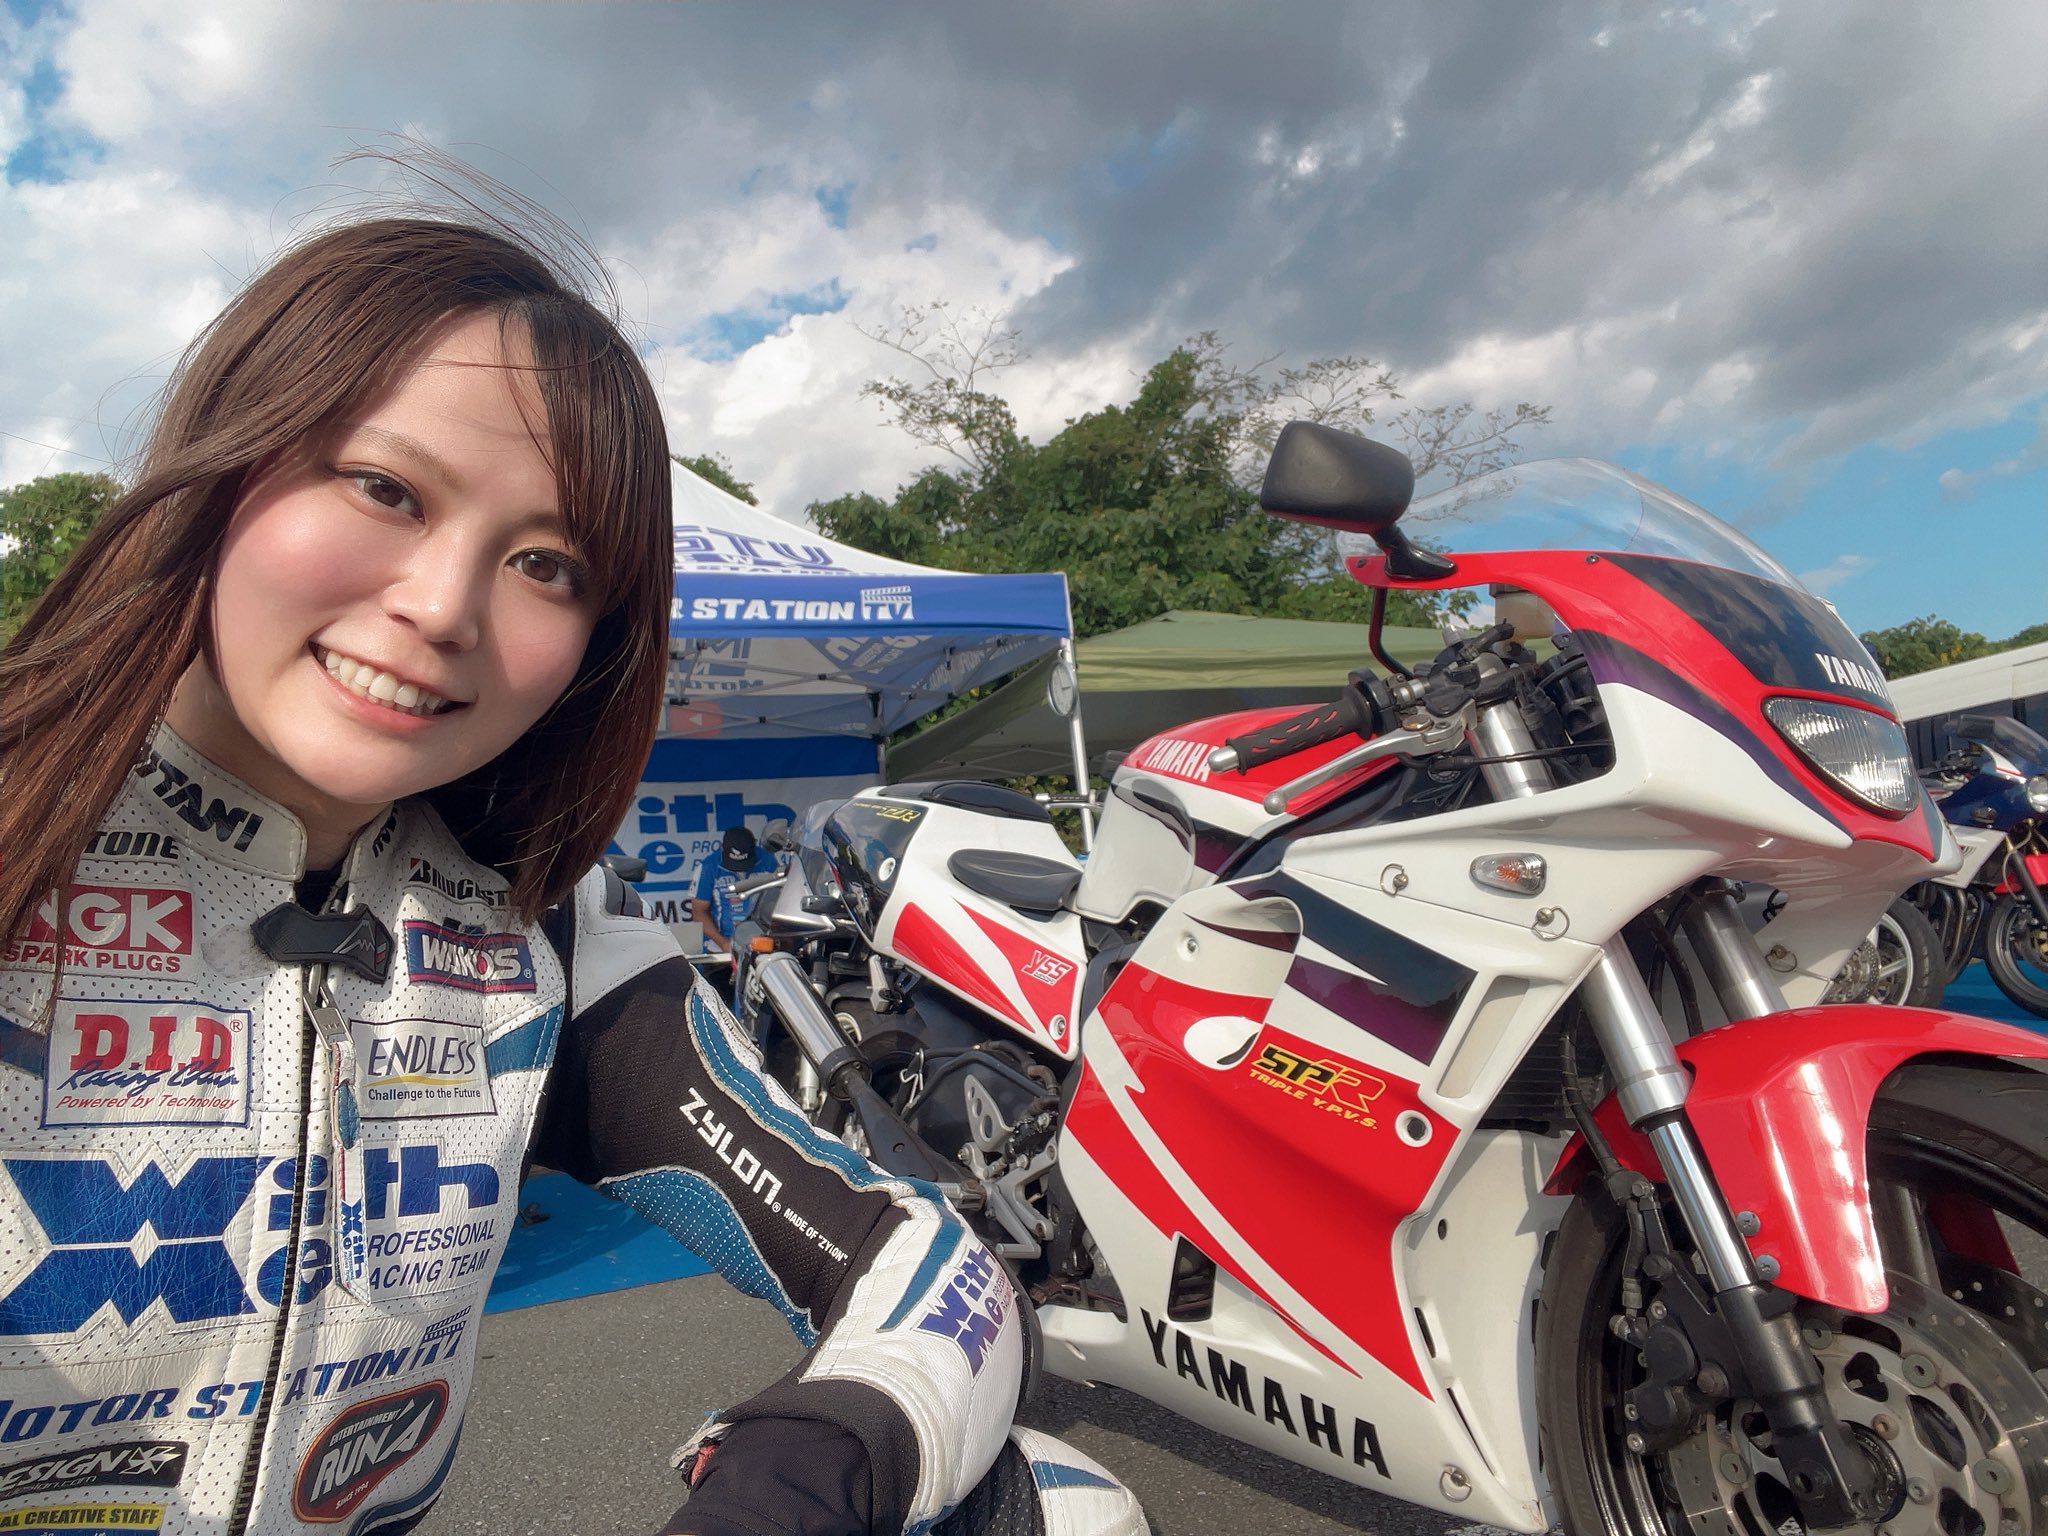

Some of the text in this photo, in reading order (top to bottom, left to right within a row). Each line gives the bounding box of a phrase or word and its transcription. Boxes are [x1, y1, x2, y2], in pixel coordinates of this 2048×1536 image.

[691, 598, 855, 620] STATION
[1143, 738, 1220, 783] YAMAHA
[148, 750, 264, 853] TANI
[638, 793, 797, 833] ith
[4, 943, 181, 973] SPARK PLUGS
[1020, 950, 1073, 980] YSS
[368, 1035, 476, 1077] ENDLESS
[57, 1060, 239, 1097] Racing Chain
[368, 1087, 481, 1101] Challenge to the Future
[1251, 1043, 1387, 1113] SPR
[56, 1094, 239, 1110] Powered by Technology
[1249, 1069, 1378, 1130] TRIPLE Y.P.V.S.
[367, 1219, 494, 1258] ROFESSIONAL
[784, 1207, 808, 1233] MADE
[805, 1224, 819, 1239] OF
[449, 1249, 490, 1279] TEAM
[1140, 1306, 1393, 1480] YAMAHA
[329, 1409, 401, 1447] ENTERTAINMENT
[0, 1449, 132, 1491] ESIGN
[25, 1509, 106, 1524] CREATIVE
[109, 1508, 160, 1524] STAFF
[335, 1491, 354, 1510] SINCE
